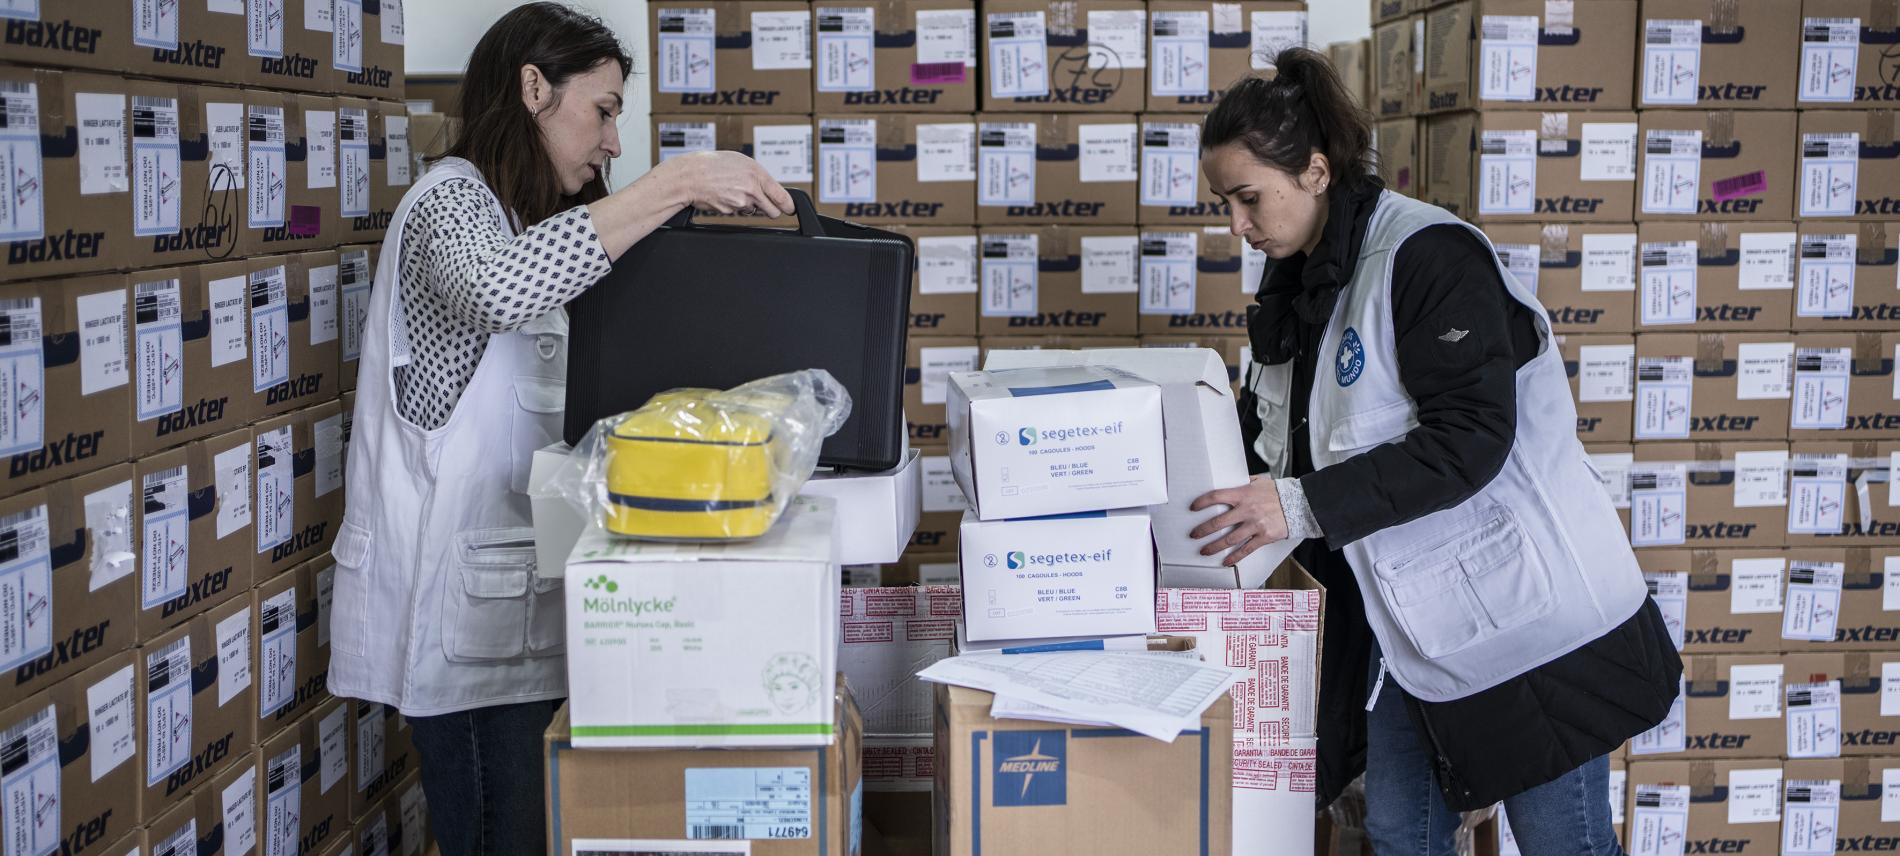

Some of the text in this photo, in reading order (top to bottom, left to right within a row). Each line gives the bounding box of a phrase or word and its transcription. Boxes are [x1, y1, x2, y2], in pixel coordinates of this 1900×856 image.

[5, 19, 101, 54] Baxter
[681, 88, 780, 106] Baxter
[844, 87, 943, 105] Baxter
[845, 200, 943, 217] Baxter
[1007, 199, 1105, 216] Baxter
[1341, 359, 1362, 384] MUNDO
[266, 372, 323, 406] Baxter
[156, 396, 228, 437] Baxter
[1041, 421, 1124, 440] segetex-eif
[1029, 549, 1112, 566] segetex-eif
[1280, 656, 1288, 675] BANDE
[1247, 678, 1255, 697] BANDE
[1247, 698, 1255, 706] DE
[1281, 684, 1290, 712] GARANTIE
[1270, 748, 1290, 756] BANDE
[1290, 748, 1298, 756] DE
[166, 732, 233, 797] Baxter
[1000, 760, 1060, 772] MEDLINE
[1258, 761, 1282, 769] SEALED
[768, 826, 808, 838] 649771
